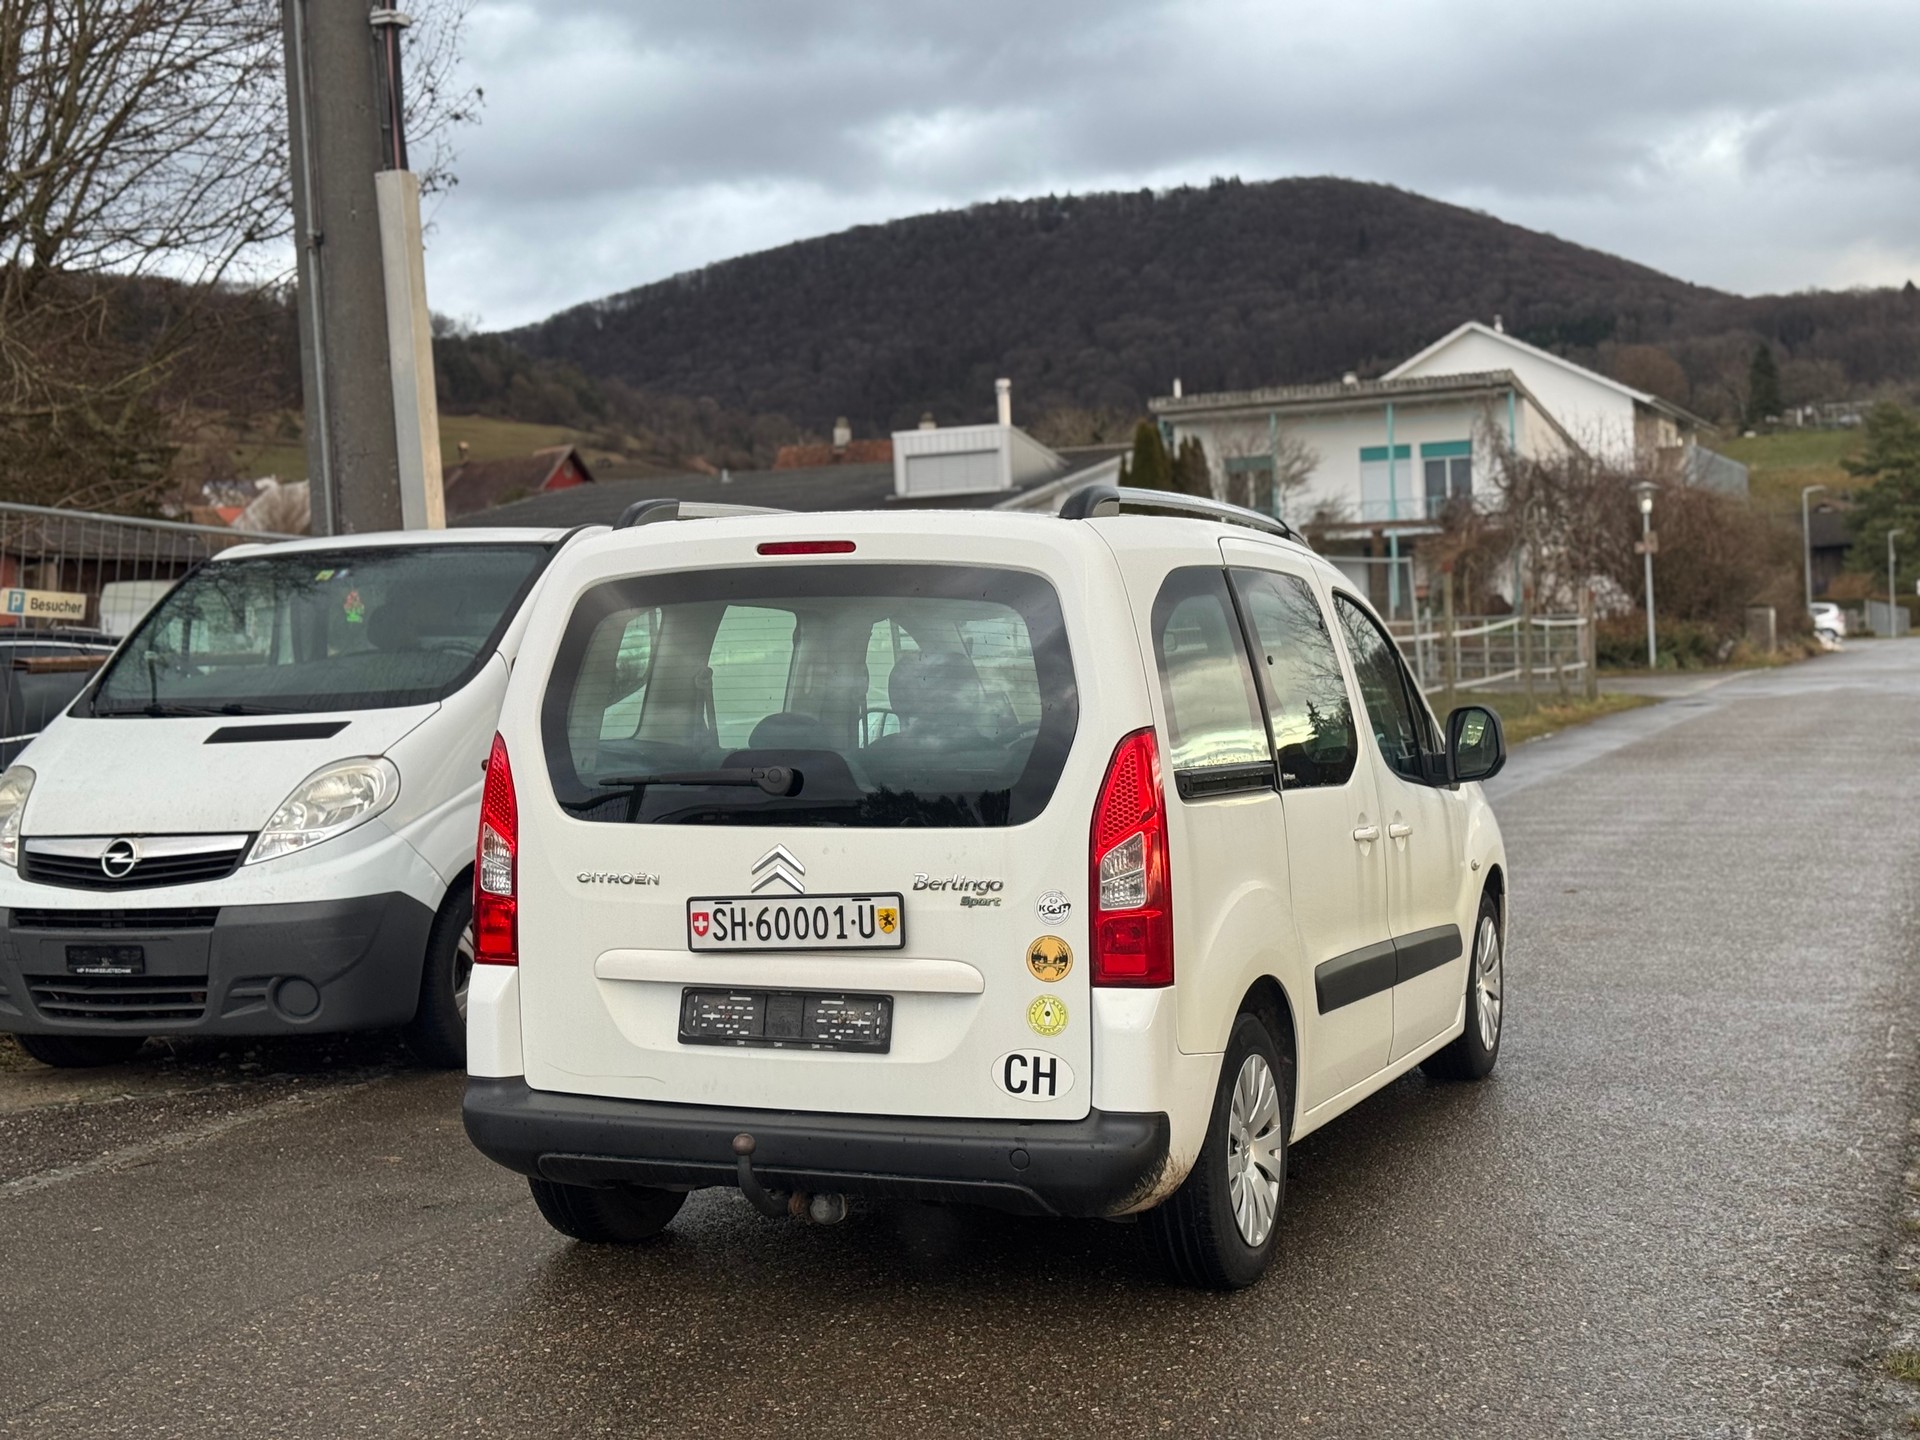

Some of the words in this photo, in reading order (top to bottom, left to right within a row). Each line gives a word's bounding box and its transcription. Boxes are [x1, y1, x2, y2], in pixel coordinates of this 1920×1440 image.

[11, 593, 22, 611] P
[31, 597, 82, 614] Besucher
[576, 871, 660, 886] CITROËN
[912, 872, 1004, 896] Berlingo
[960, 896, 1002, 908] Sport
[1004, 1053, 1057, 1097] CH
